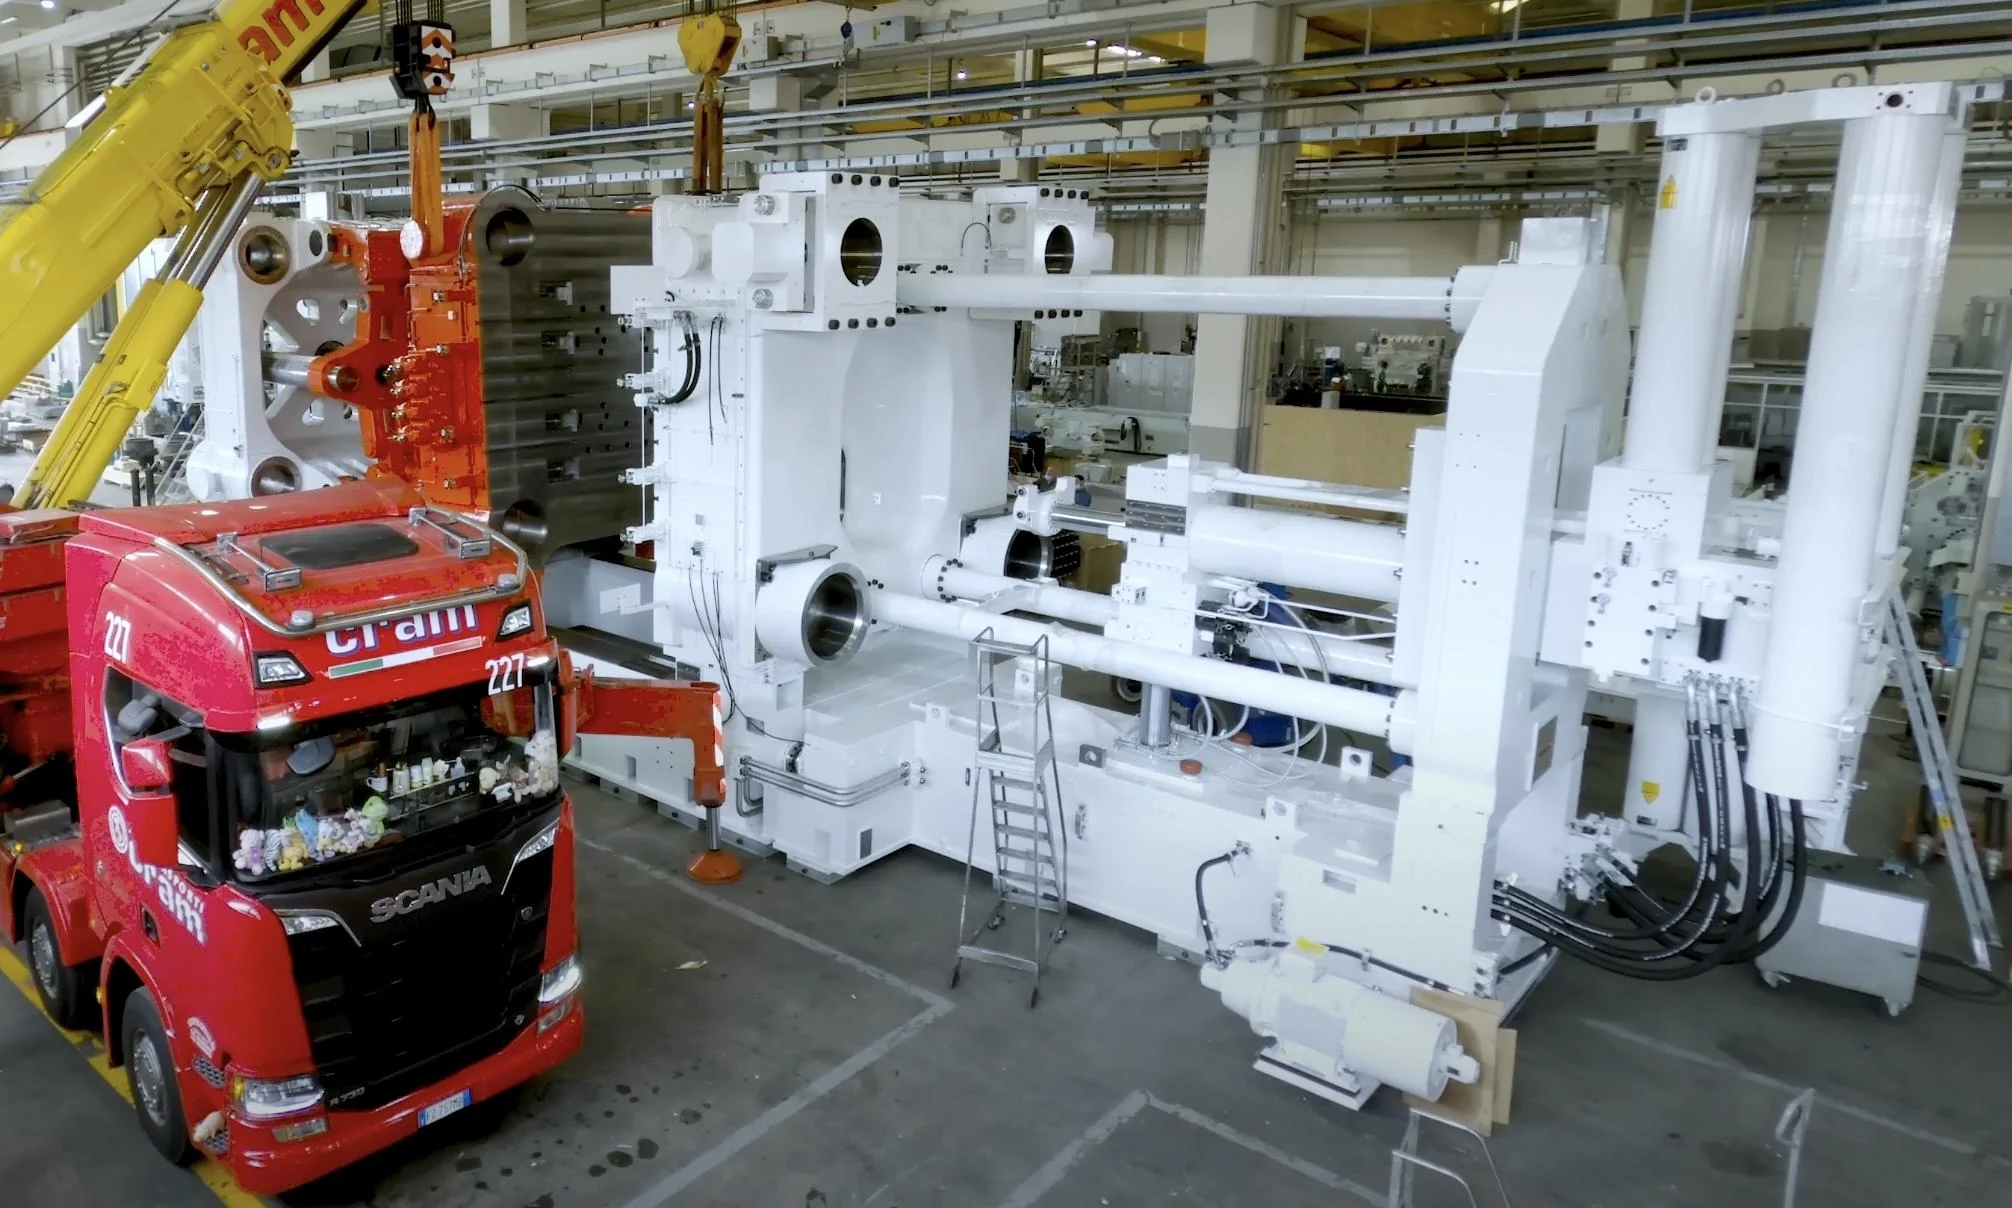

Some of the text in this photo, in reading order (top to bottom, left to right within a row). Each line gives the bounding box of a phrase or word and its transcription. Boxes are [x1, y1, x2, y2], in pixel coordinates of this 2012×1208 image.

[104, 611, 131, 664] 227
[485, 652, 524, 696] 227
[370, 864, 493, 924] SCANIA
